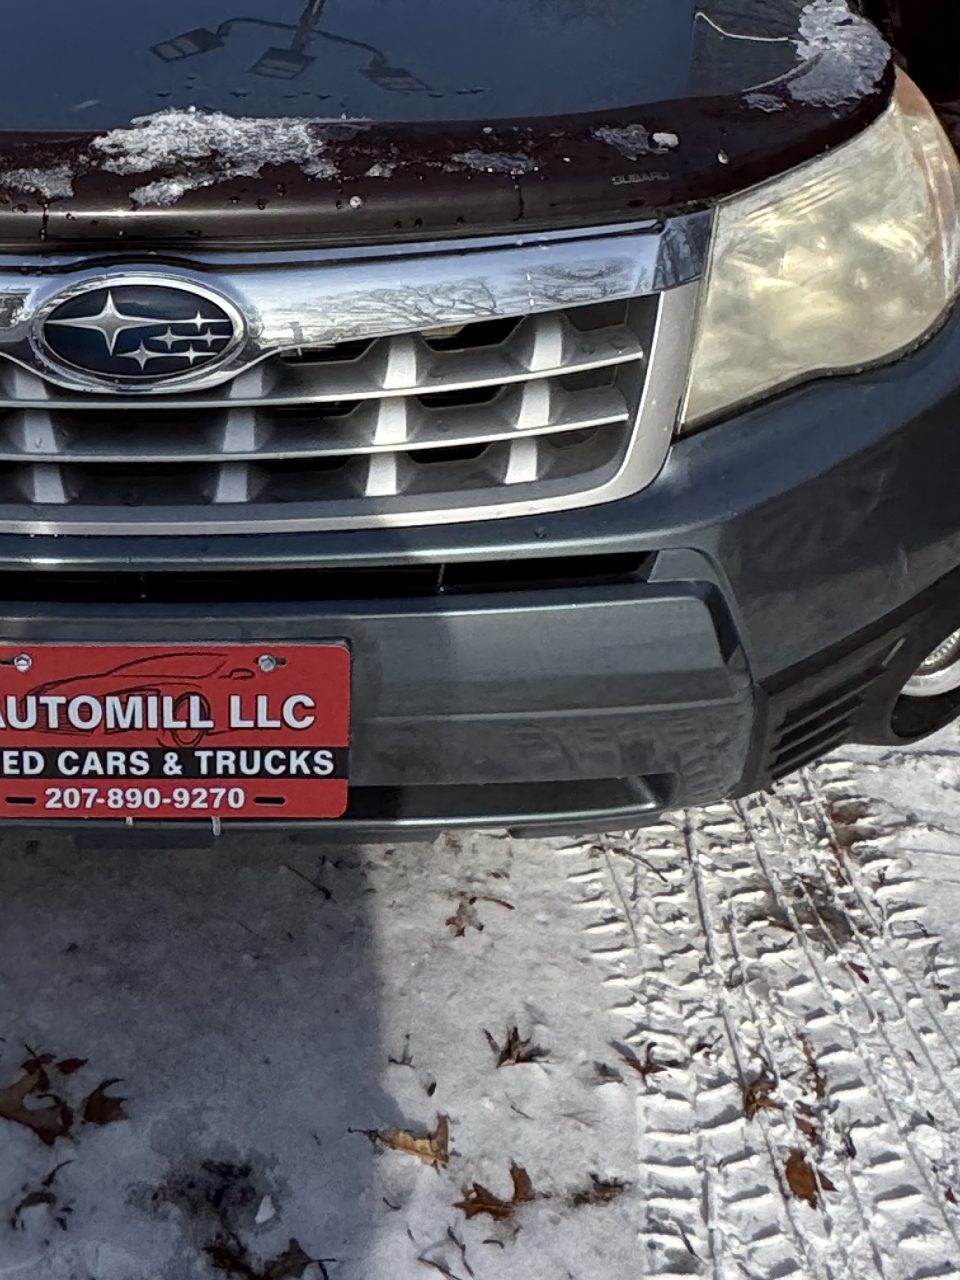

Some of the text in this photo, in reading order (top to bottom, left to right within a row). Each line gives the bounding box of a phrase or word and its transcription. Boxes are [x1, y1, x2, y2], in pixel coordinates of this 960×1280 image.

[229, 694, 316, 730] LLC
[57, 750, 150, 776] CARS
[162, 751, 183, 775] &
[194, 749, 335, 776] TRUCKS
[44, 786, 246, 810] 207-890-9270
